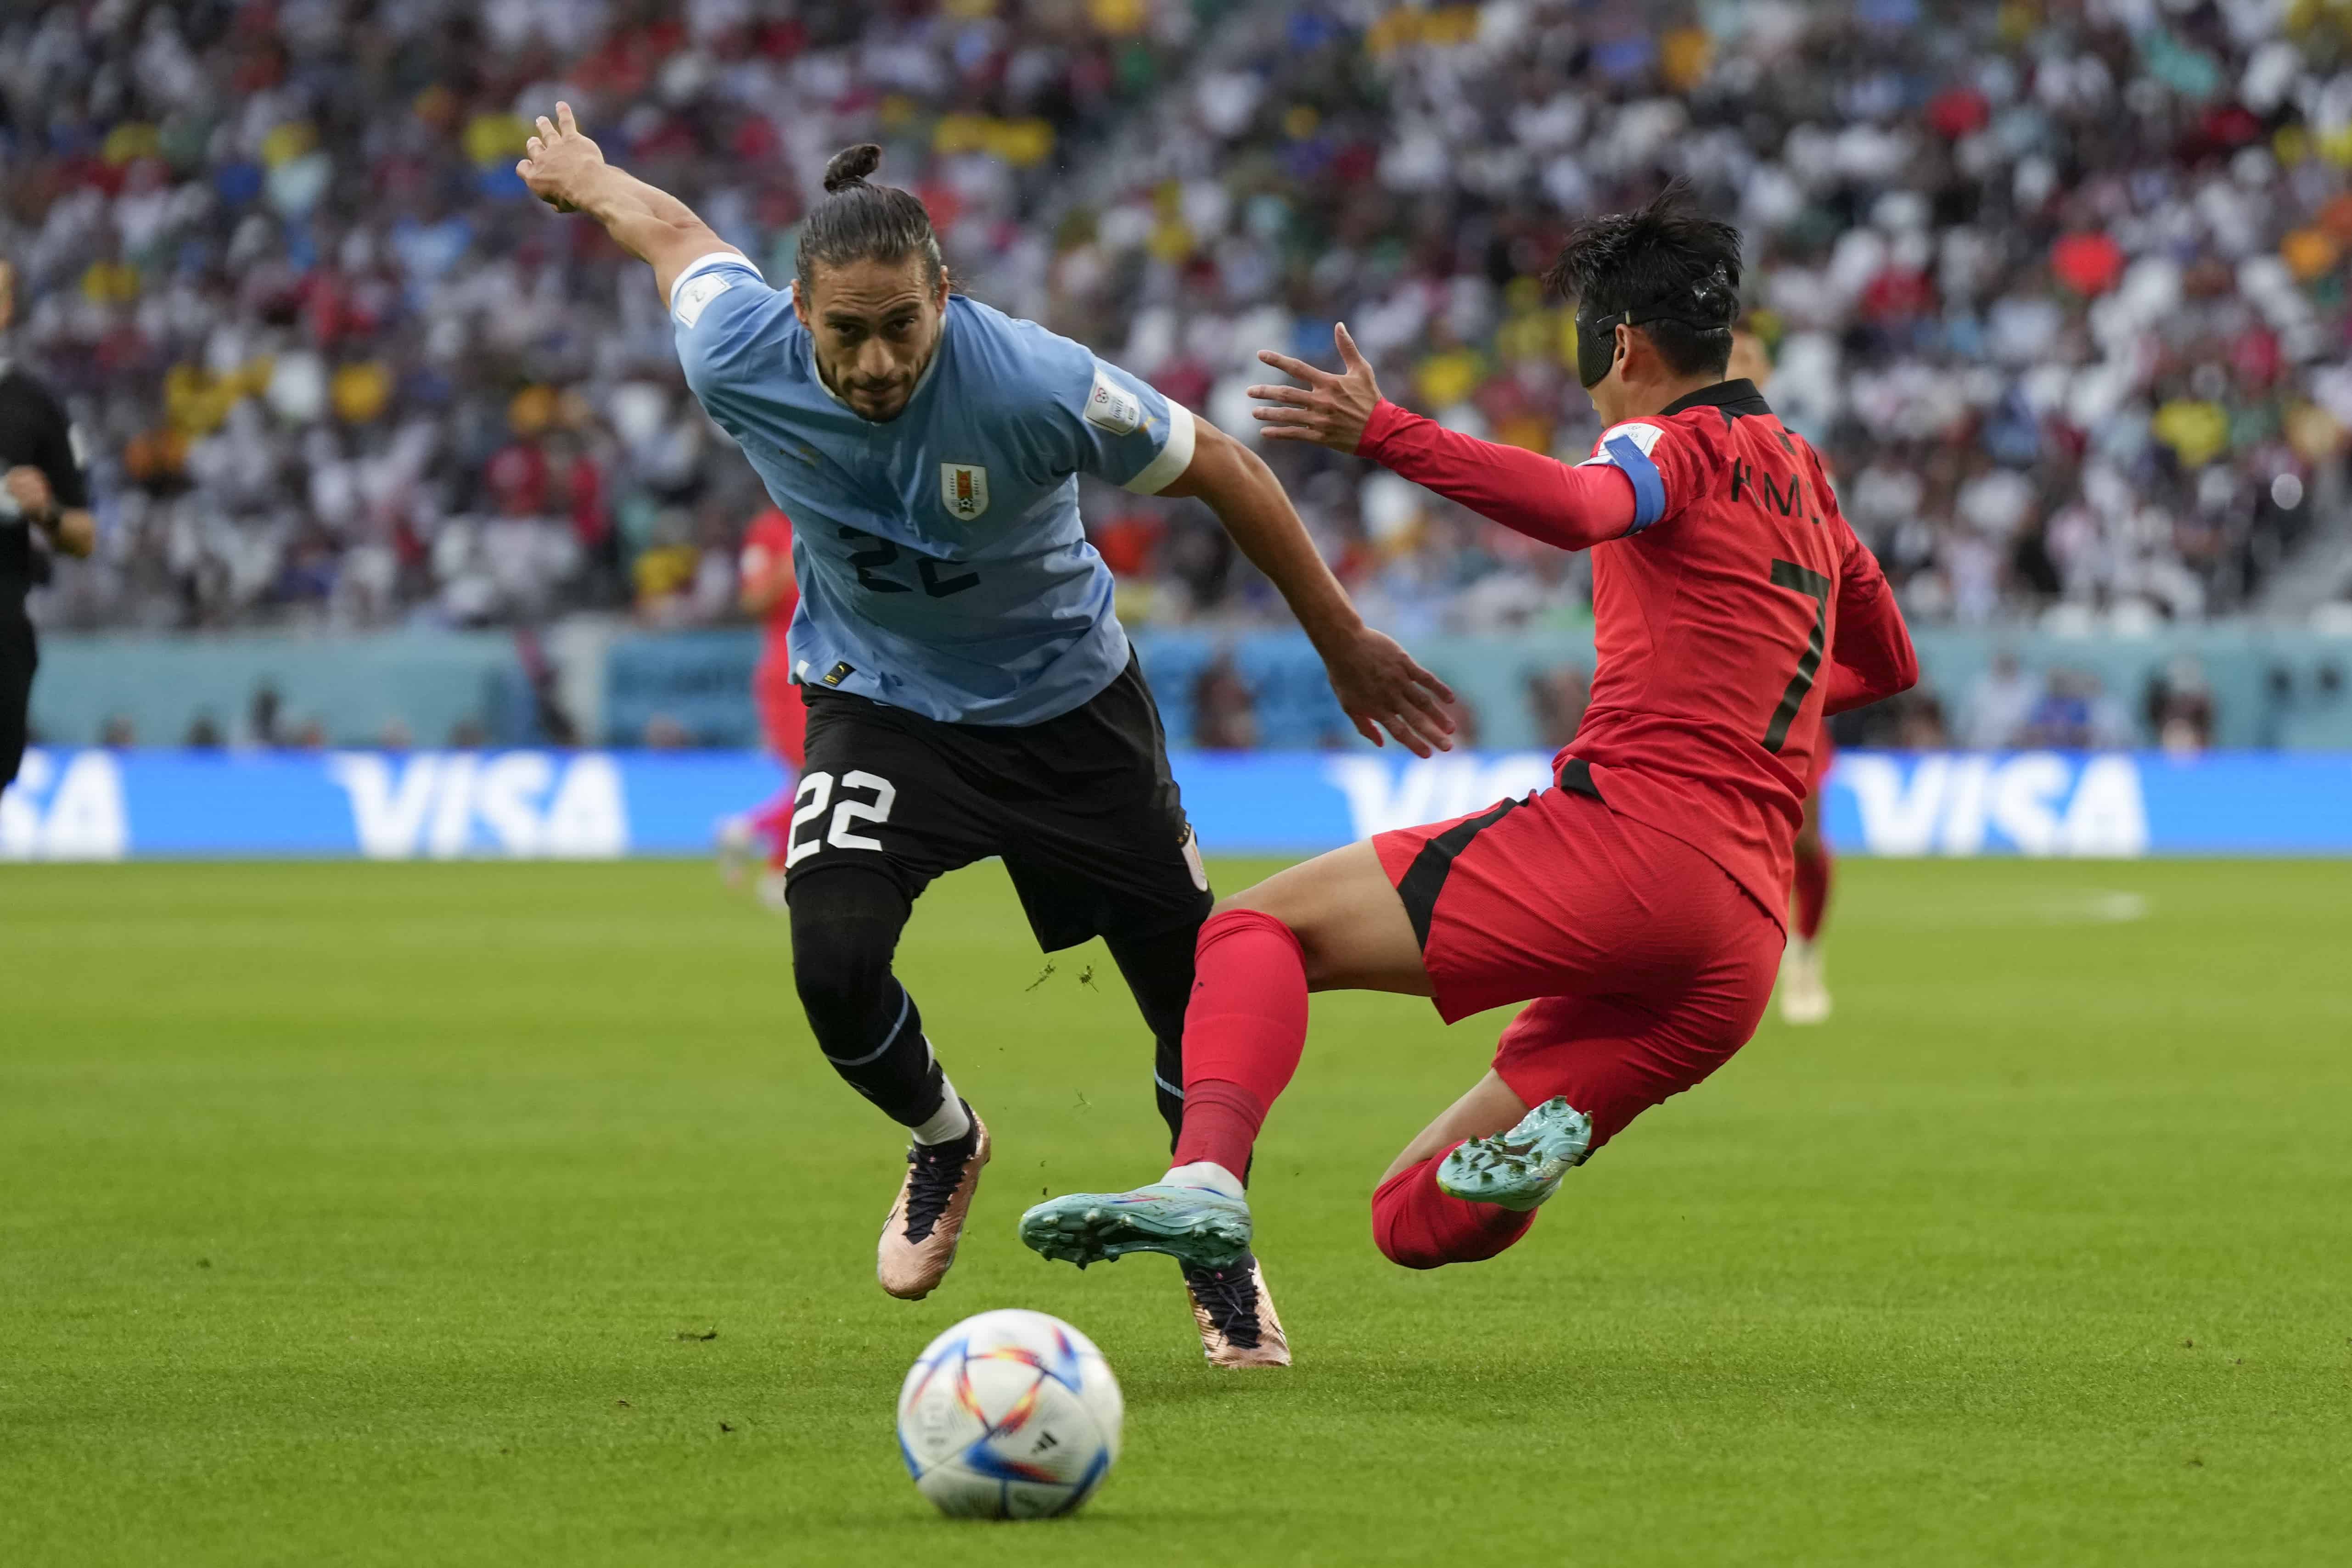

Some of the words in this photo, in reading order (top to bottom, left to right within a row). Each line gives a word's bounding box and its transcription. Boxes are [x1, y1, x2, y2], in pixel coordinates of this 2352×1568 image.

[838, 525, 981, 598] 22
[1760, 558, 1830, 754] 7
[325, 750, 626, 860] VISA
[785, 770, 896, 869] 22
[1838, 750, 2150, 858] VISA
